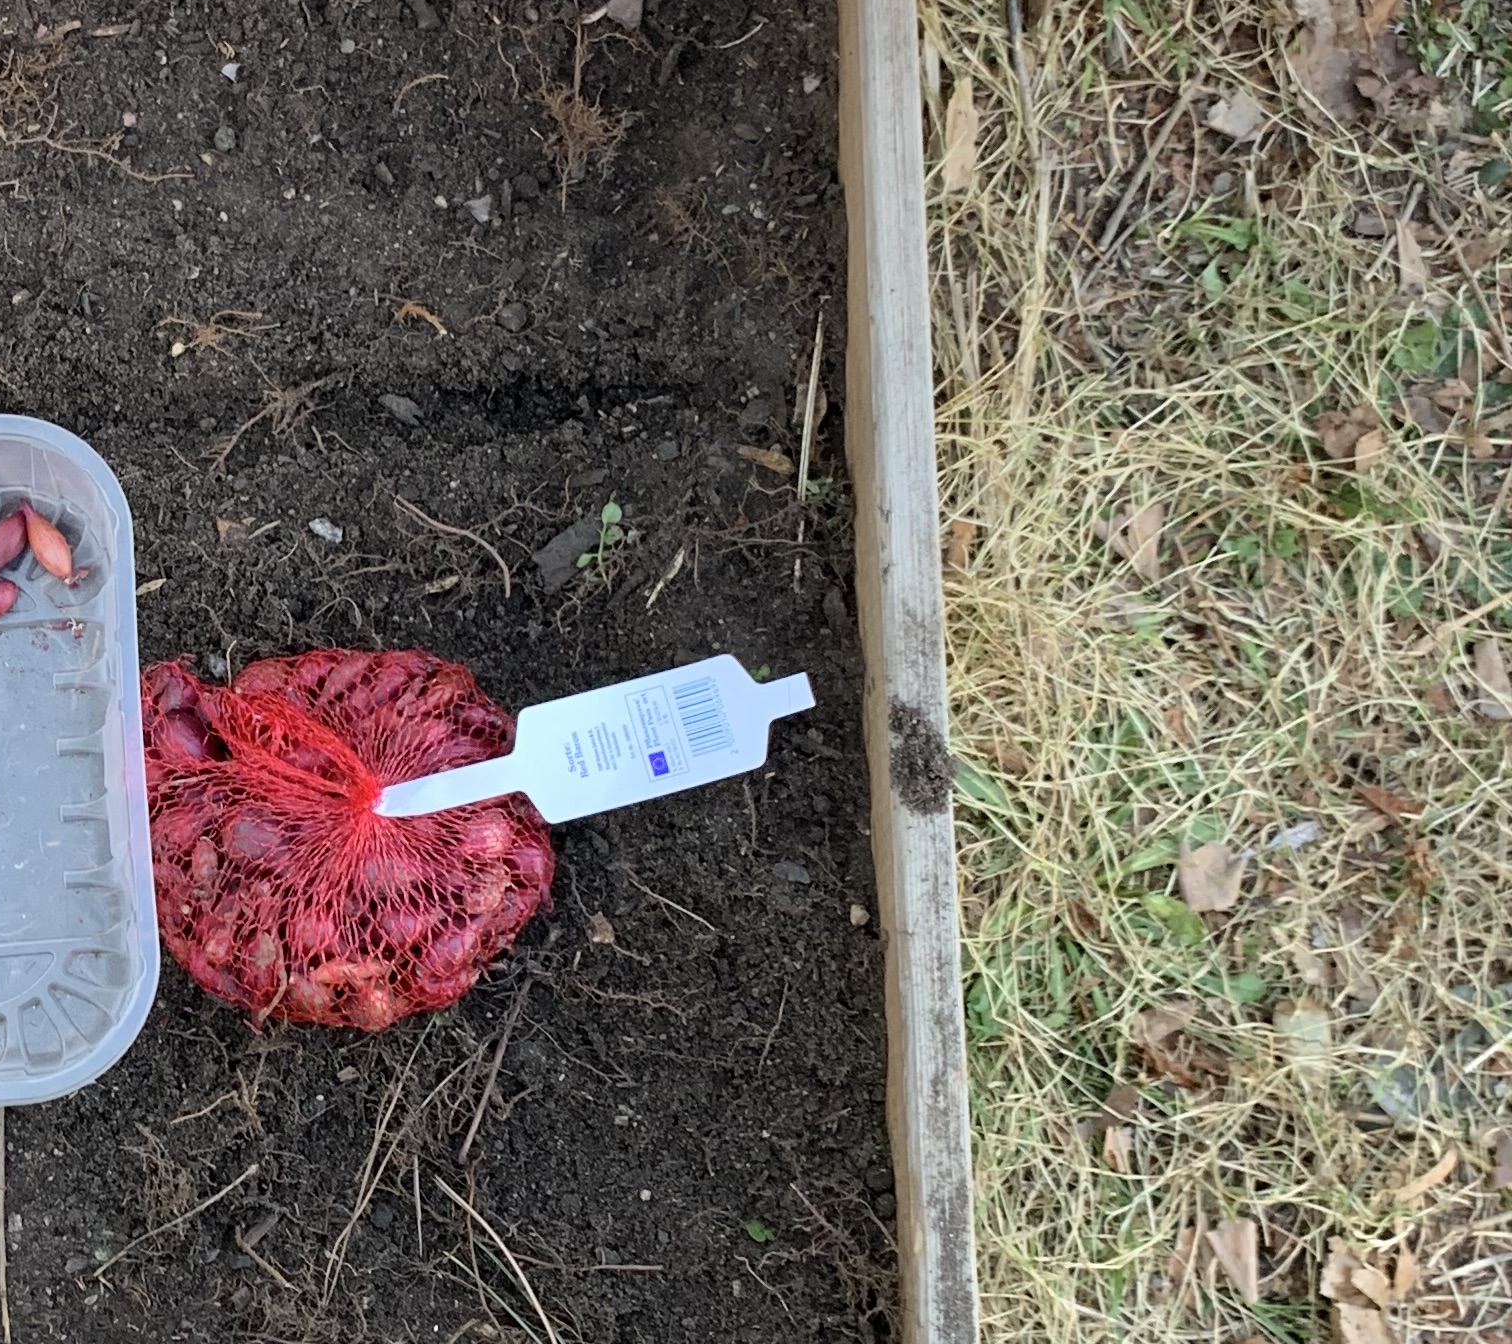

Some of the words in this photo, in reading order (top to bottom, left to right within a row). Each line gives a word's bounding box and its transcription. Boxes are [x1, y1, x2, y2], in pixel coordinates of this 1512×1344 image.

[564, 742, 577, 773] Sorte:
[571, 731, 584, 758] Baron
[576, 760, 589, 779] Red
